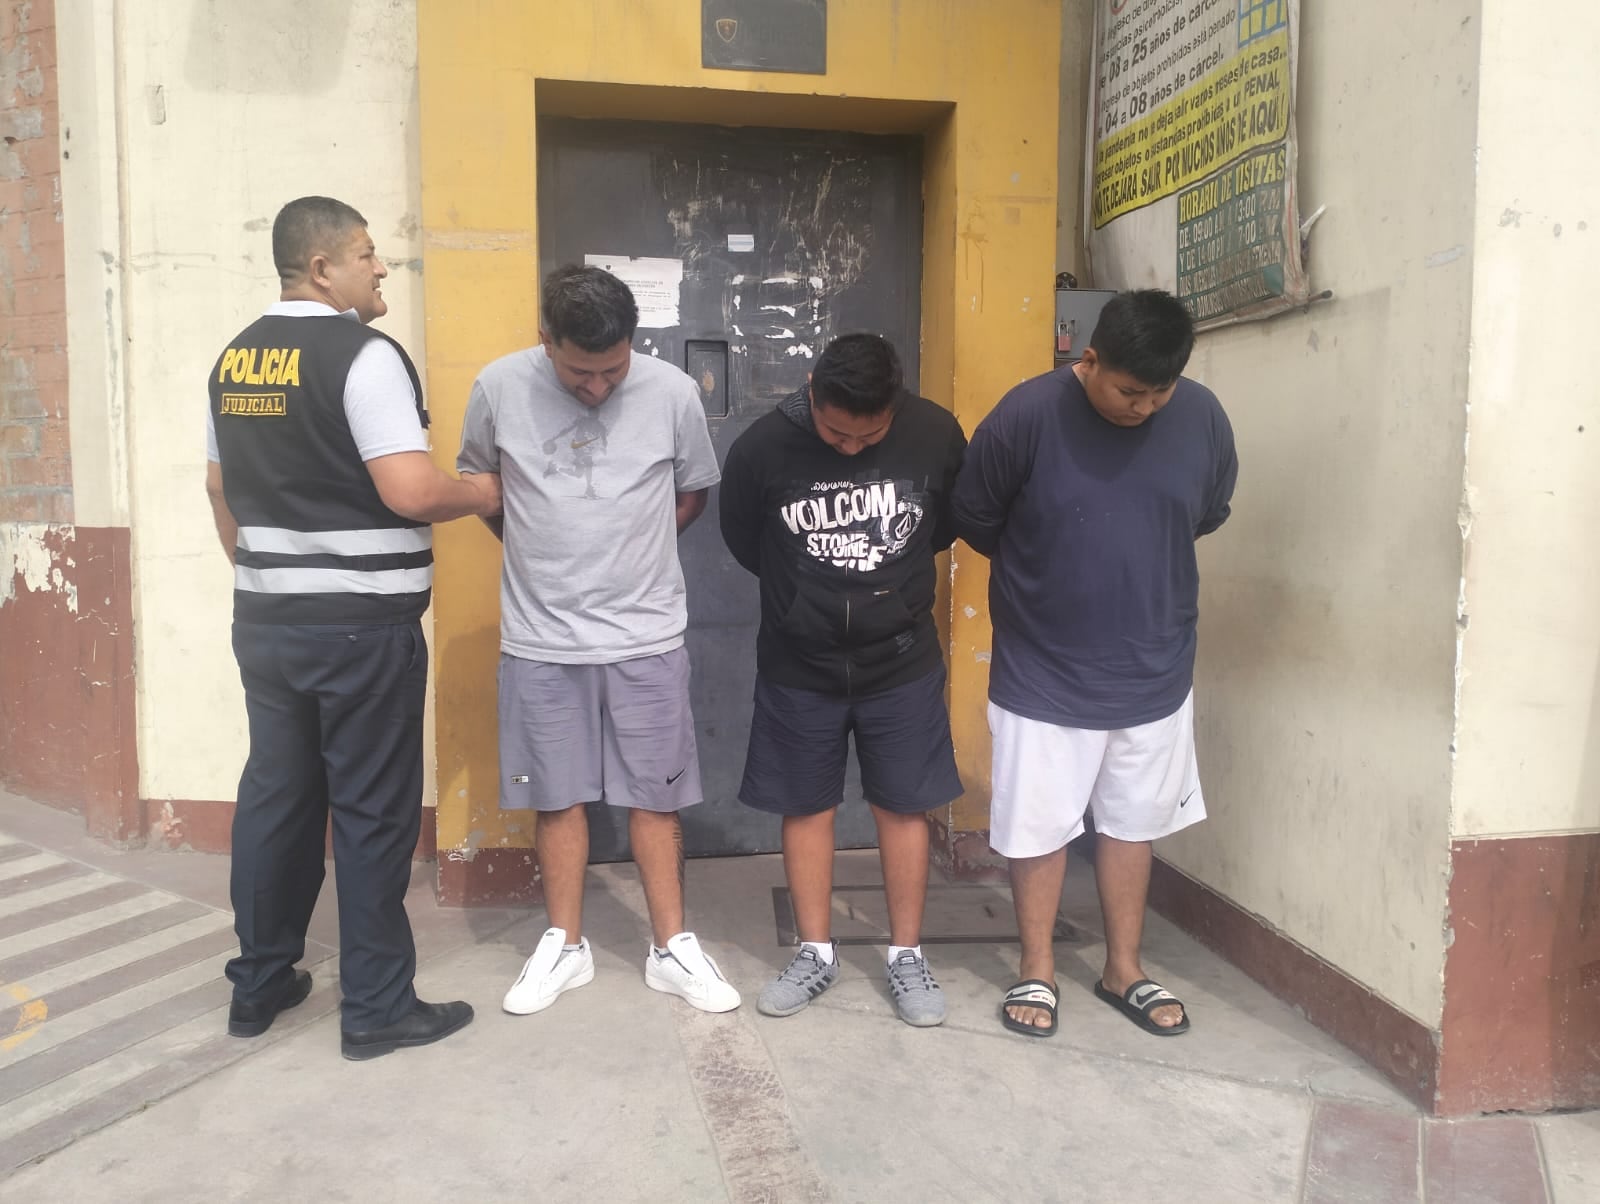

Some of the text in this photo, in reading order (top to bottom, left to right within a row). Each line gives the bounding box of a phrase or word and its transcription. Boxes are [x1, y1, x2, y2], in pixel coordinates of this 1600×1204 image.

[1131, 37, 1148, 68] 25
[1173, 15, 1186, 36] de
[1129, 91, 1148, 119] 08
[1149, 83, 1172, 109] años
[1174, 72, 1187, 92] de
[1244, 67, 1281, 102] PENAL
[1138, 126, 1149, 142] no
[1179, 148, 1286, 225] HORARIO DE VISITAS
[219, 348, 301, 387] POLICIA
[223, 397, 283, 413] JUDICIAL
[780, 482, 896, 535] VOLCOM
[806, 530, 870, 558] STONE
